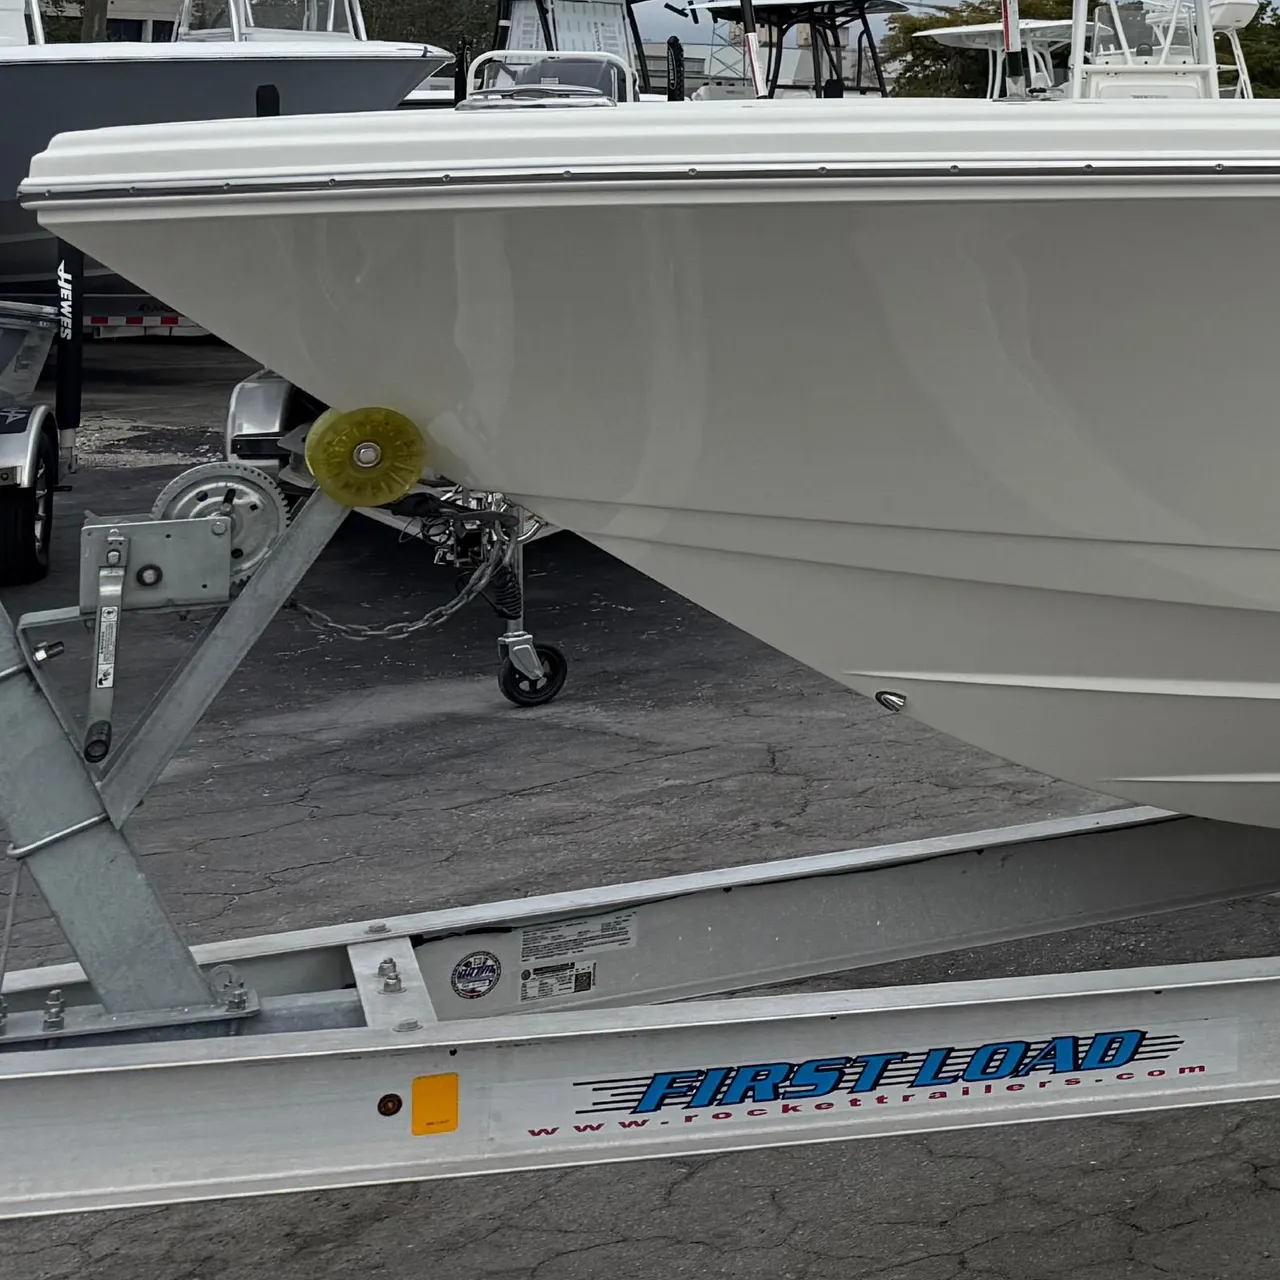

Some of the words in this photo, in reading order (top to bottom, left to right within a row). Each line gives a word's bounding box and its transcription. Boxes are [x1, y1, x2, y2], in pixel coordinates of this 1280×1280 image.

[57, 260, 72, 340] HEWES
[629, 1050, 908, 1115] FIRST
[907, 1029, 1149, 1088] LOAD
